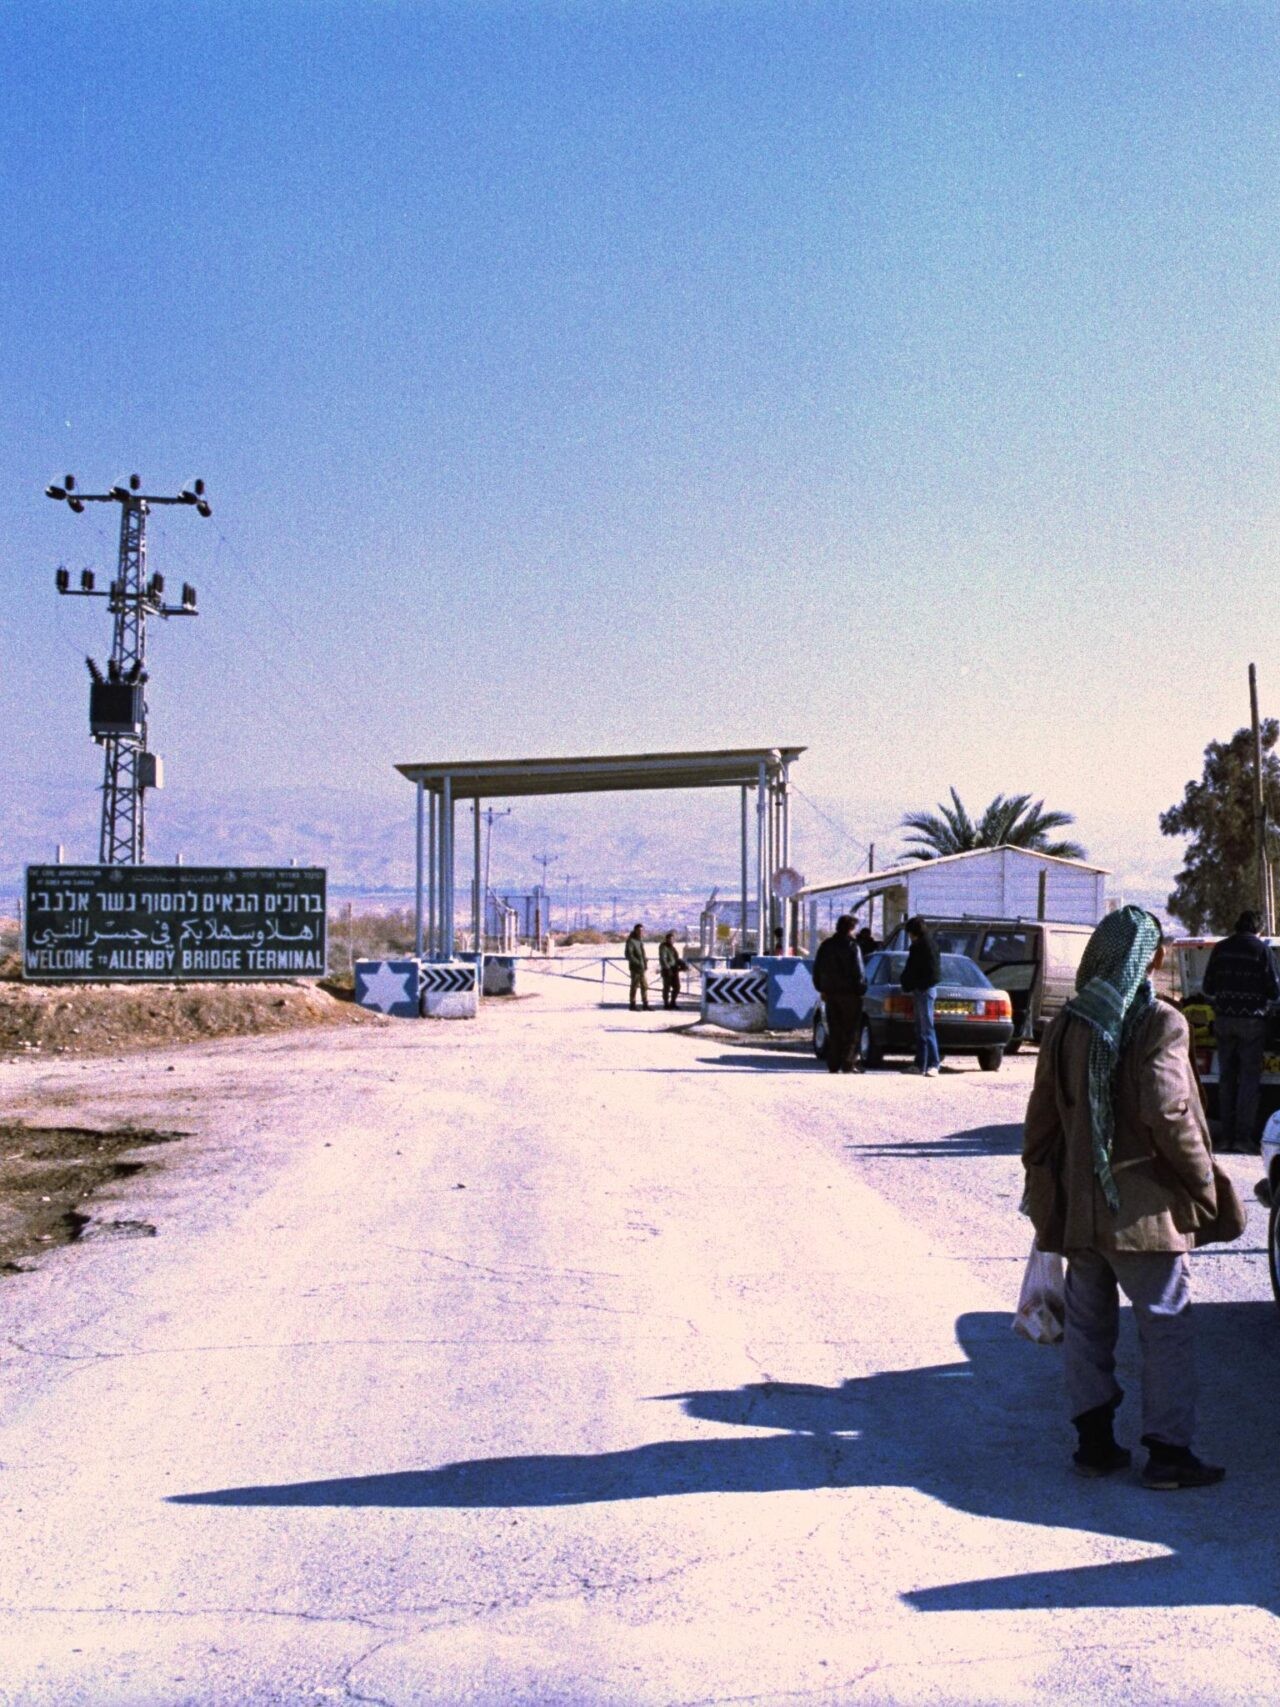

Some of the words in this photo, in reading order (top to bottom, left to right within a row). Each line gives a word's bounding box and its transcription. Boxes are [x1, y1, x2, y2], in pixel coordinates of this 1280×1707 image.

[202, 892, 260, 913] הבאים
[26, 948, 94, 970] WELCOME
[108, 949, 177, 970] ALLENBY
[182, 950, 242, 970] BRIDGE
[246, 950, 324, 970] TERMINAL
